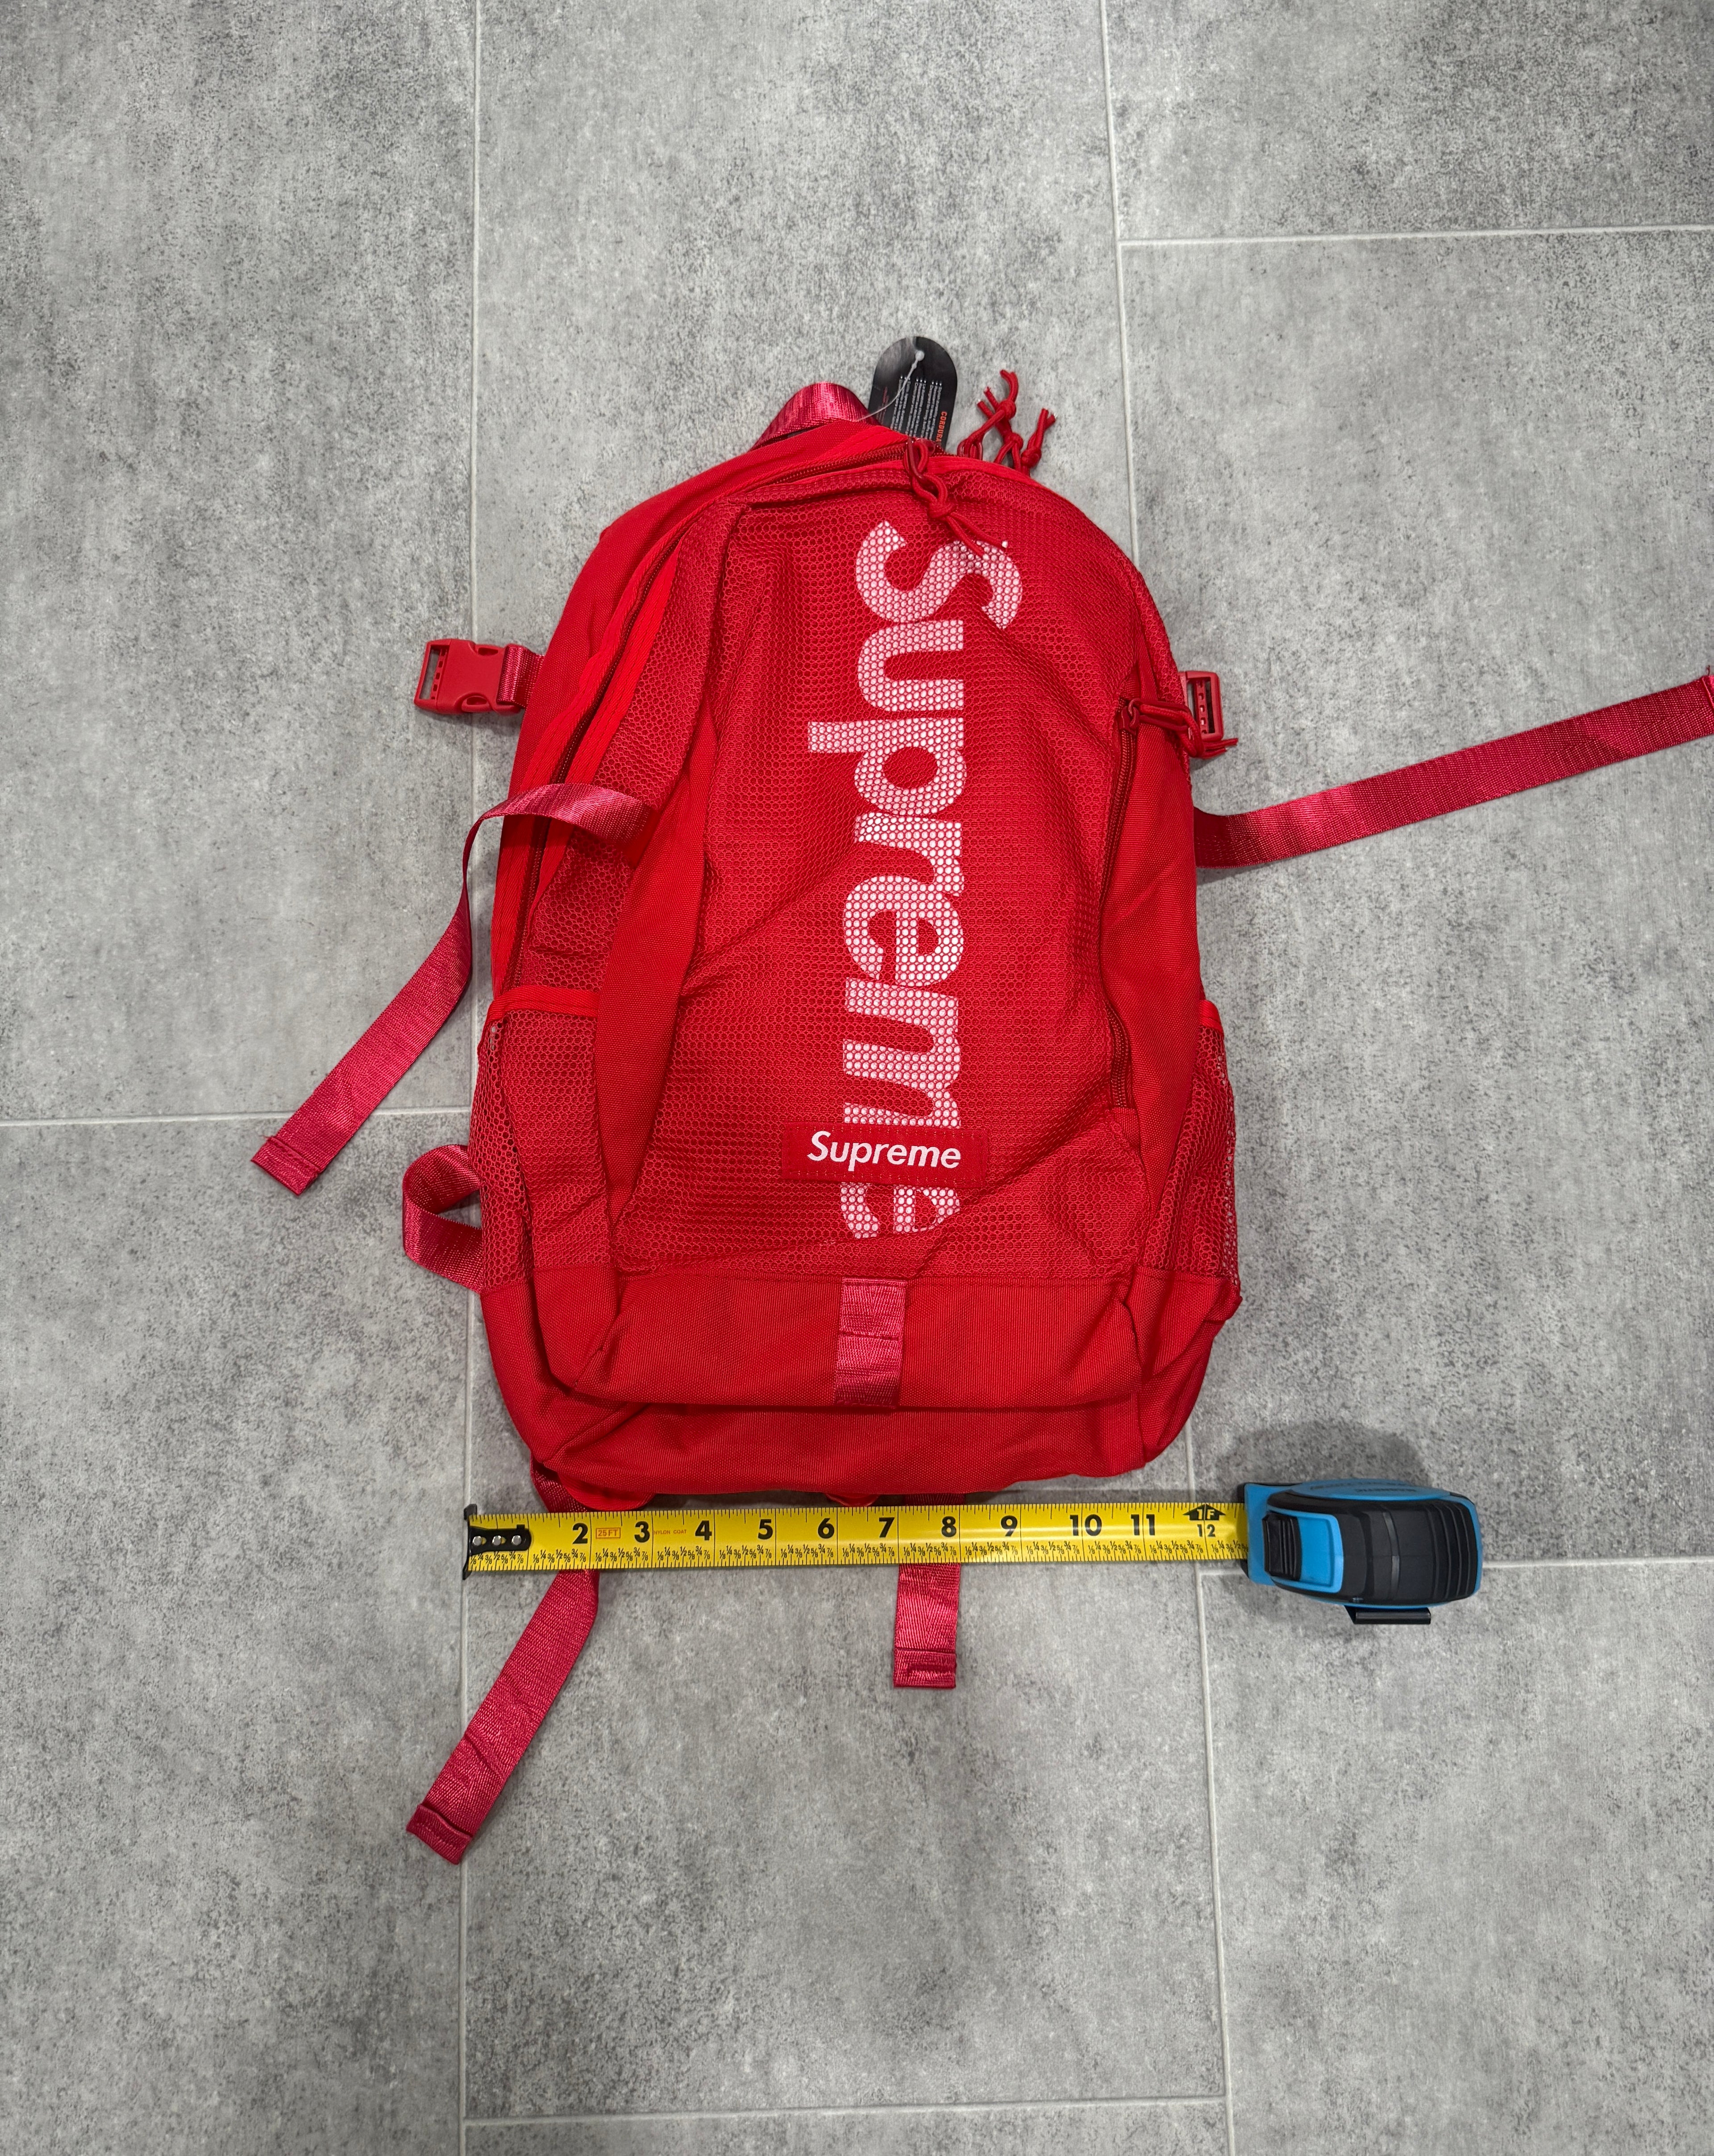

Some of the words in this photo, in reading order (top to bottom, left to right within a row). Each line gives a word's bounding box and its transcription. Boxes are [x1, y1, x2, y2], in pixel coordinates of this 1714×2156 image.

[936, 411, 947, 442] CORDURA
[807, 1130, 961, 1172] Supreme
[572, 1523, 588, 1544] 2
[634, 1521, 650, 1543] 3
[695, 1520, 712, 1540] 4
[758, 1519, 773, 1540] 5
[818, 1518, 834, 1539] 6
[879, 1518, 894, 1537] 7
[941, 1516, 957, 1537] 8
[1000, 1515, 1018, 1536] 9
[1069, 1514, 1102, 1536] 10
[1131, 1514, 1155, 1536] 11
[1198, 1524, 1215, 1537] 12
